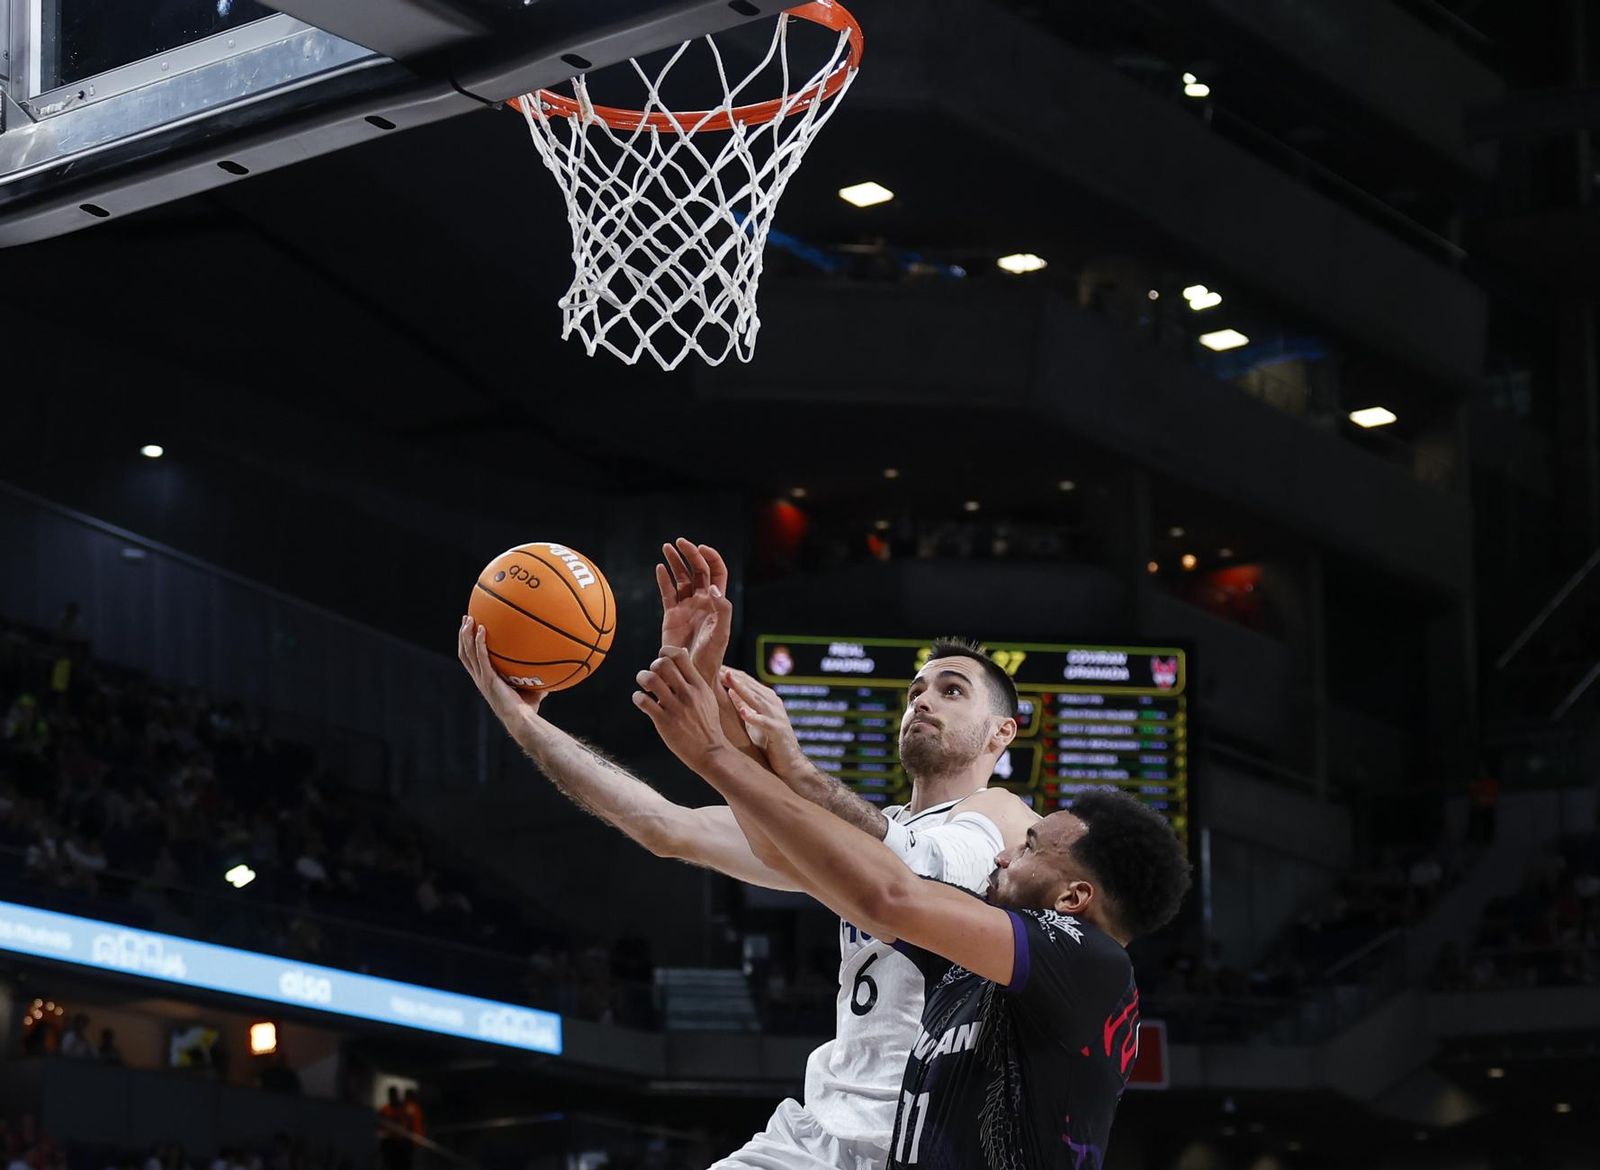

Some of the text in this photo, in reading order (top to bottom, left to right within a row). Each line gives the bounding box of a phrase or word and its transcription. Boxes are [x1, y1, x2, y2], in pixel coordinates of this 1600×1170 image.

[509, 565, 540, 589] acb
[850, 952, 878, 1016] 6
[895, 1089, 930, 1164] 11
